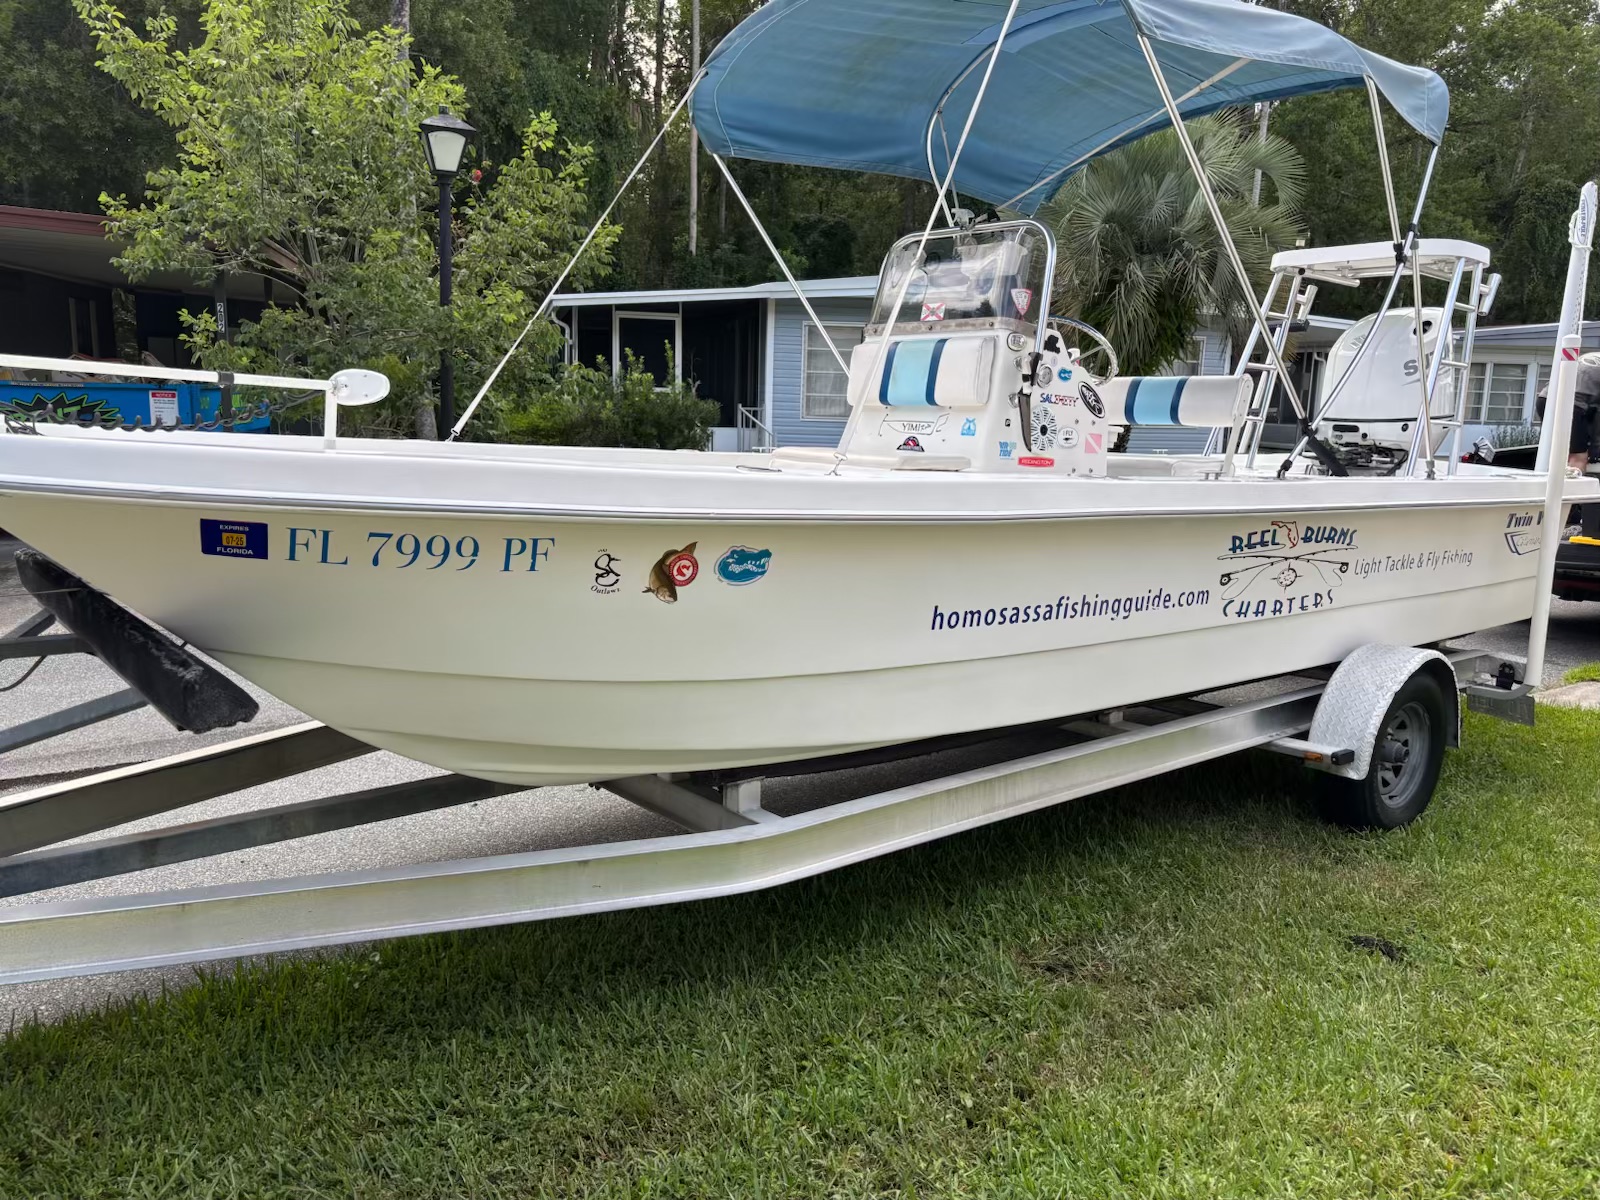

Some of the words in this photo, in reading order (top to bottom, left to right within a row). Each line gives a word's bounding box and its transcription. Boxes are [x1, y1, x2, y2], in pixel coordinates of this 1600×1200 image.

[217, 303, 225, 333] 202
[219, 524, 249, 532] EXPIRES
[1506, 511, 1533, 528] Twin
[216, 546, 254, 556] FLORIDA
[225, 535, 244, 546] 07-25
[284, 527, 348, 566] FL
[366, 531, 480, 571] 7999
[500, 537, 556, 572] PF
[1229, 529, 1280, 553] REEL
[1300, 526, 1357, 546] BURNS
[1354, 559, 1382, 579] Light
[1385, 554, 1414, 573] Tackle
[1416, 555, 1423, 568] &
[1426, 552, 1440, 571] Fly
[931, 588, 1210, 631] homosassafishingguide.com
[1223, 589, 1334, 618] CHARTERS
